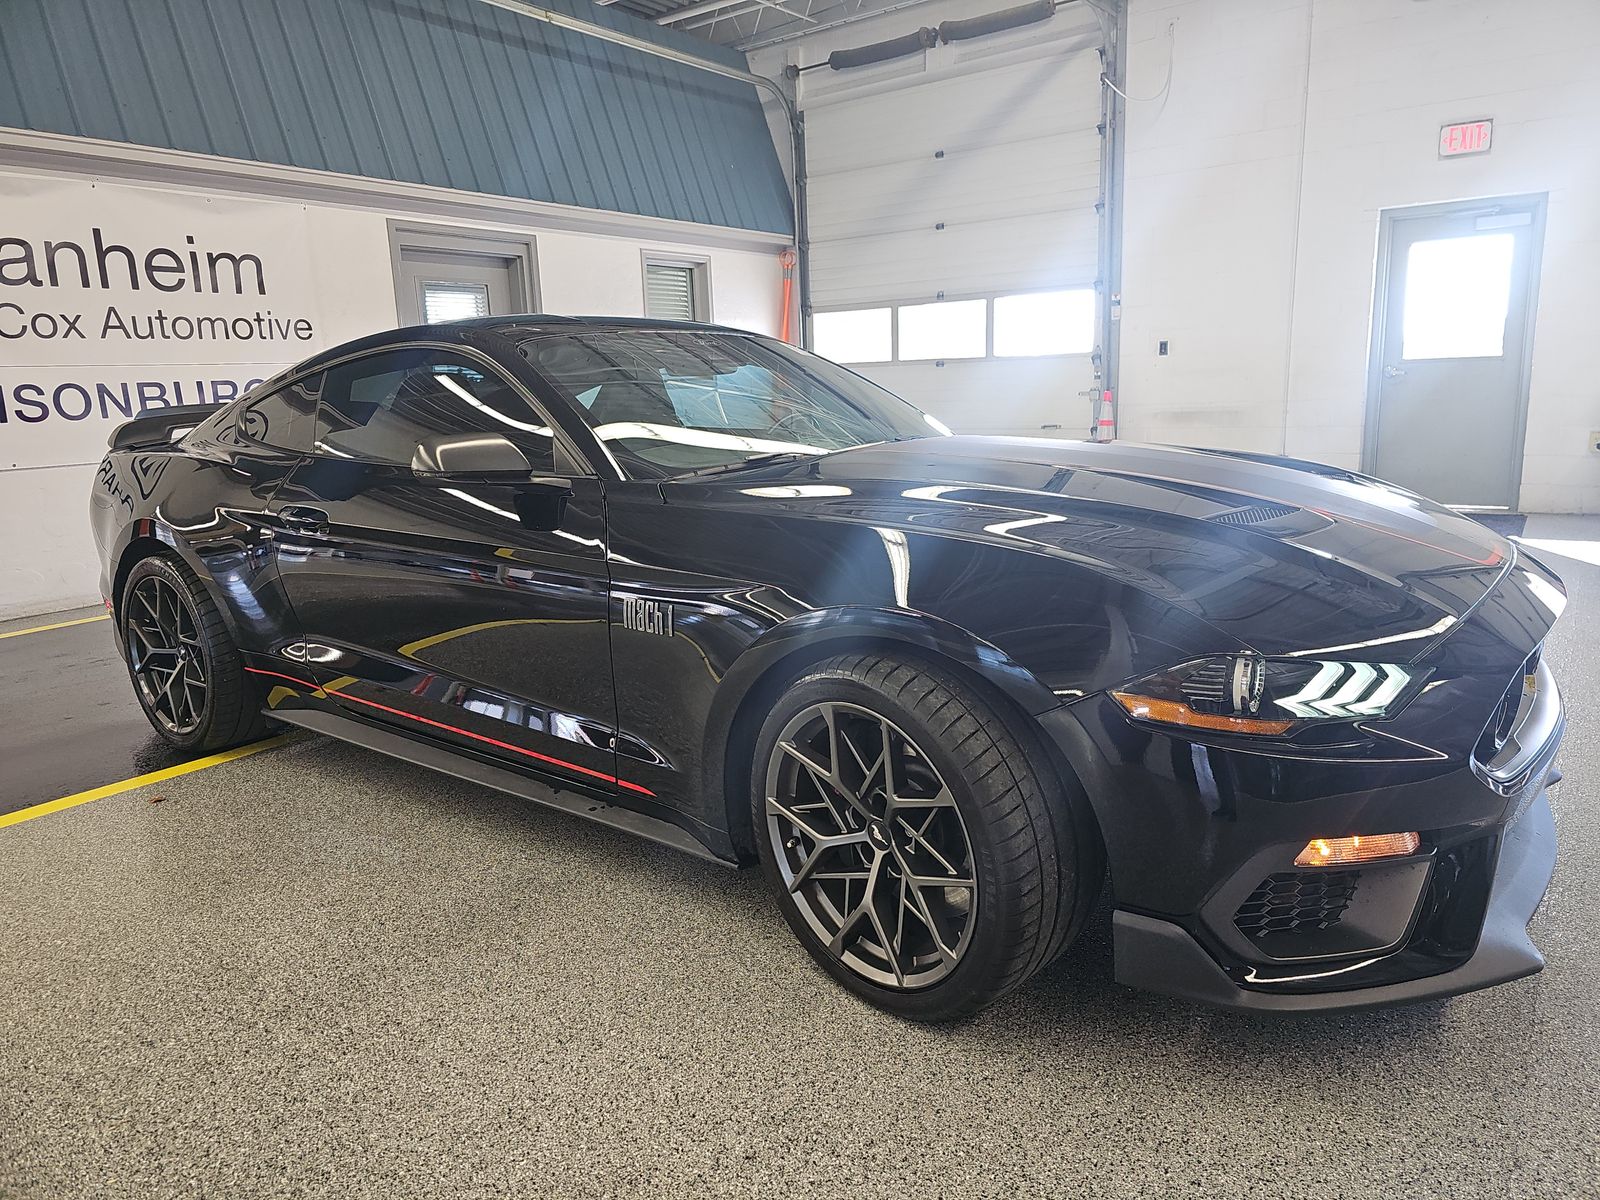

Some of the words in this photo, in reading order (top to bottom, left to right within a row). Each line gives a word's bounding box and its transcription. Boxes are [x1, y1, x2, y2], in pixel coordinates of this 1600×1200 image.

[1448, 124, 1485, 152] EXIT
[0, 228, 266, 295] anheim
[0, 303, 86, 339] Cox
[101, 306, 313, 341] Automotive
